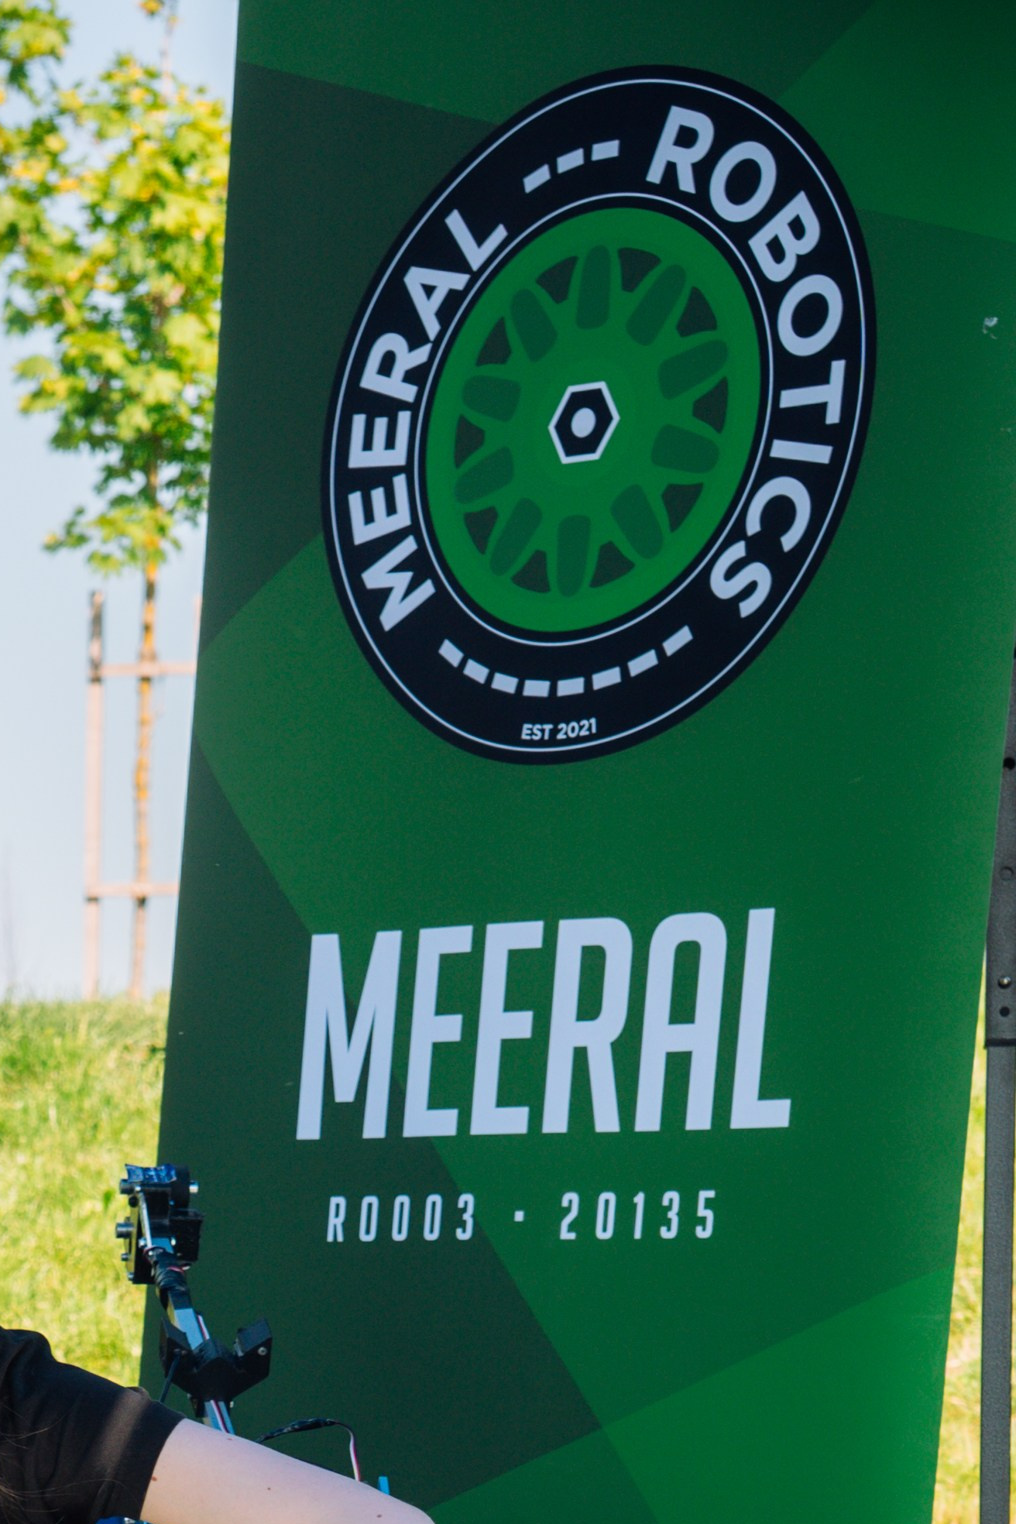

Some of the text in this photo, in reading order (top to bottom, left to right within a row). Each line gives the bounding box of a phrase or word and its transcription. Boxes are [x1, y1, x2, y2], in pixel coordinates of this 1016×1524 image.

[348, 105, 846, 632] MEERAL ROBOTICS
[521, 717, 596, 740] EST 2021
[296, 908, 791, 1140] MEERAL
[559, 1190, 716, 1240] 20135
